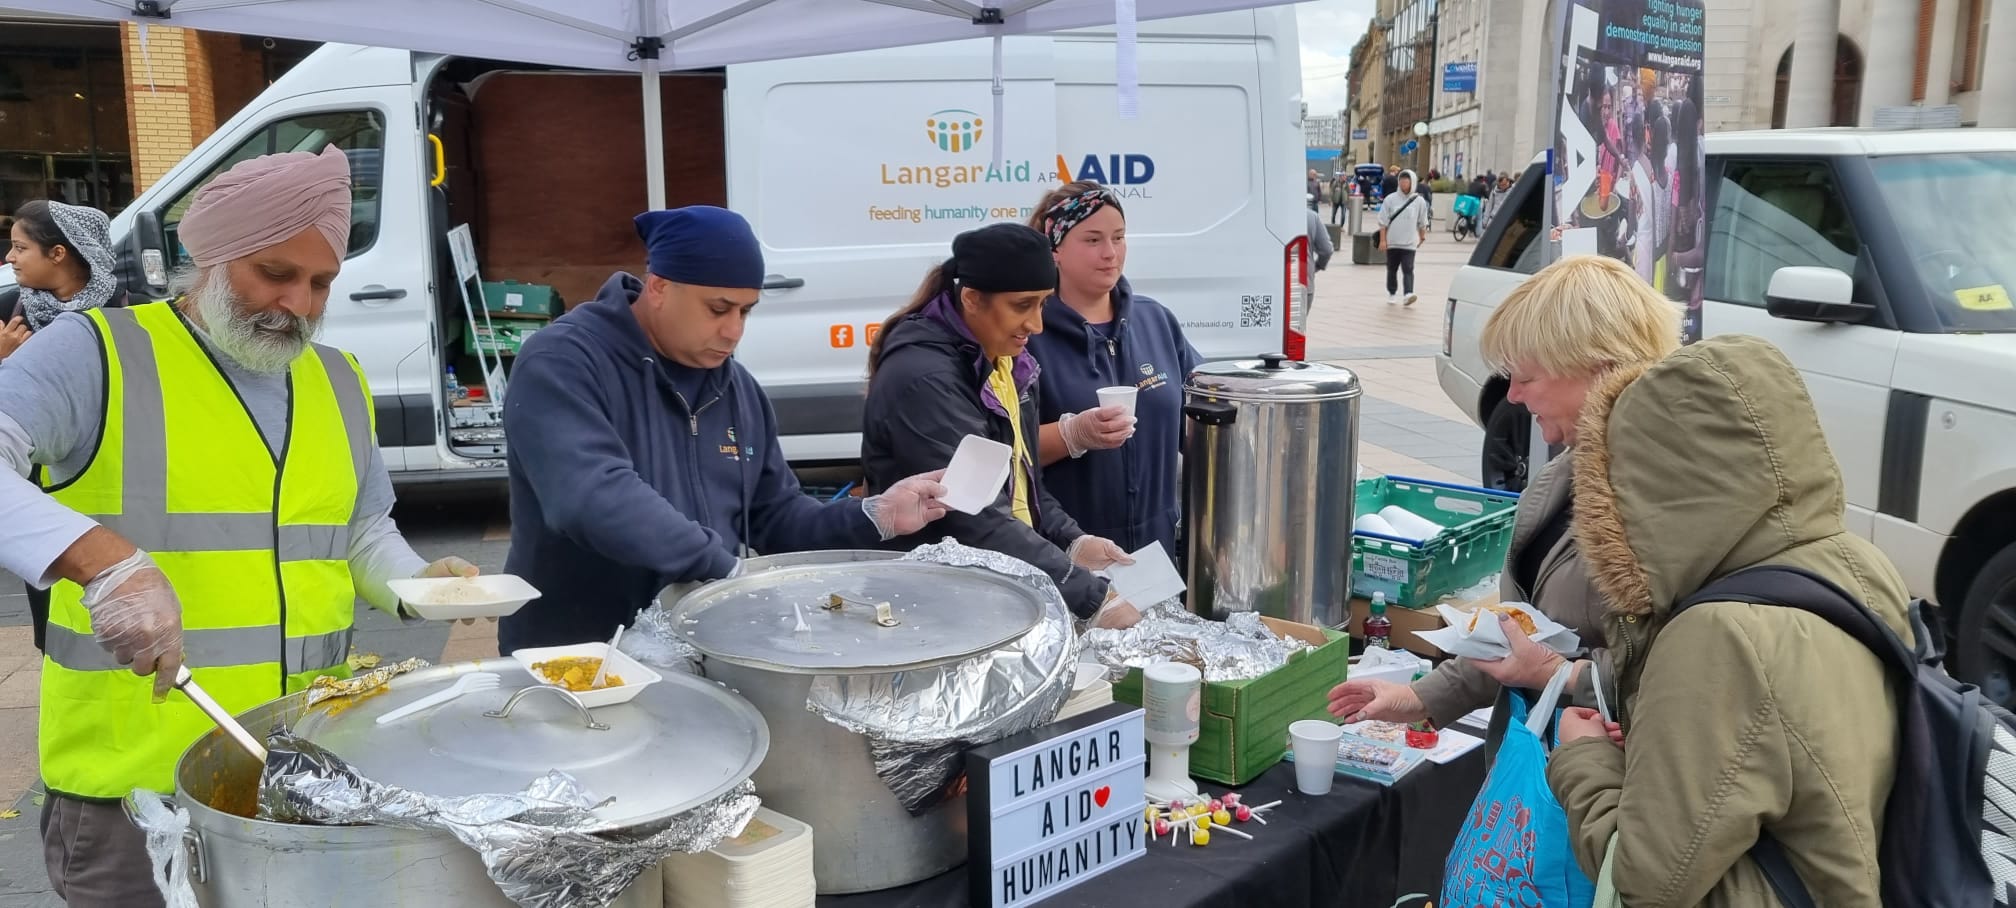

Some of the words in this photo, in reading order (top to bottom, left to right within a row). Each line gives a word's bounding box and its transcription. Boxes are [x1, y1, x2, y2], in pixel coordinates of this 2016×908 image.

[1643, 14, 1669, 33] equality
[1670, 17, 1678, 32] in
[1680, 20, 1703, 36] action
[1676, 2, 1703, 20] hunger
[1606, 22, 1660, 48] demonstrating
[1660, 36, 1702, 53] compassion
[881, 160, 1030, 188] LangarAid
[1076, 153, 1155, 185] AID
[869, 205, 921, 223] feeding
[924, 204, 988, 222] humanity
[990, 207, 1017, 219] one
[1180, 319, 1234, 329] w.khalsaaid.org
[1014, 729, 1121, 798] LANGAR
[1041, 789, 1092, 838] AID
[1003, 818, 1138, 904] HUMANITY
